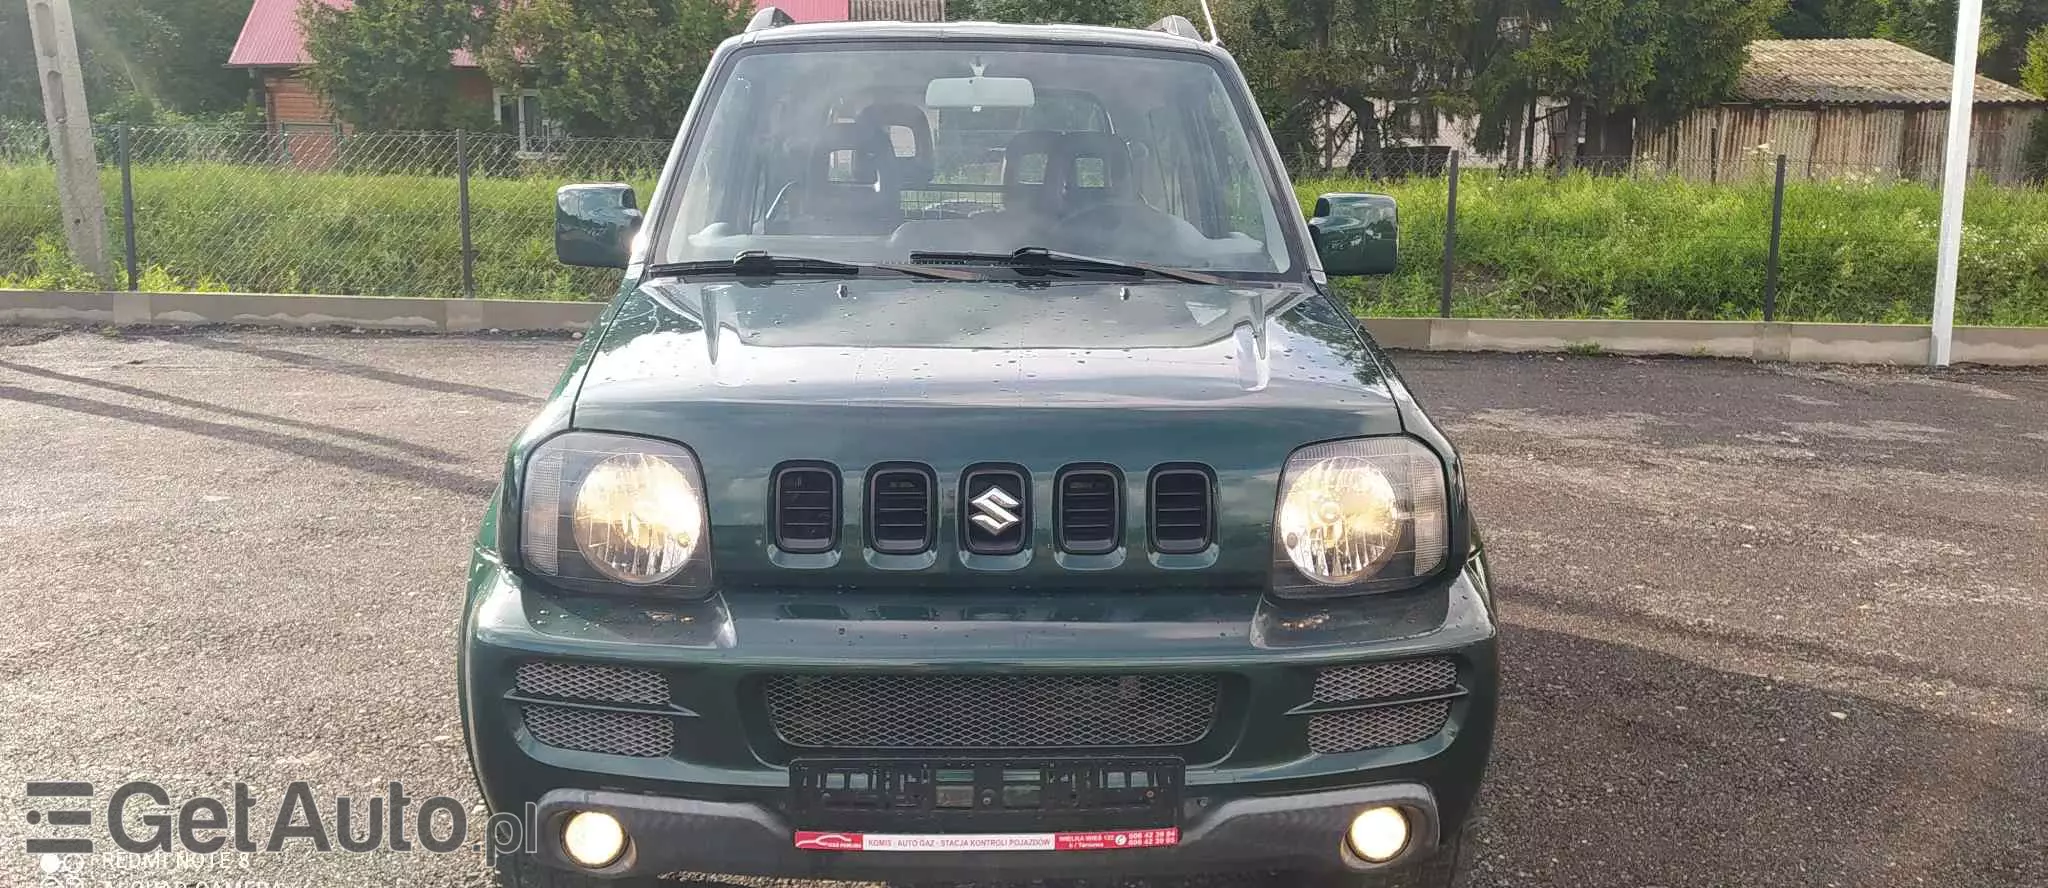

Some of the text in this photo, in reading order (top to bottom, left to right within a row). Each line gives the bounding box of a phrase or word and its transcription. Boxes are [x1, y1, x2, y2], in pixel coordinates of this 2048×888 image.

[868, 839, 892, 847] KOMIS
[898, 839, 918, 847] AUTO
[919, 839, 935, 847] GAZ
[941, 839, 968, 847] STACJA
[970, 839, 1008, 847] KONTROLI
